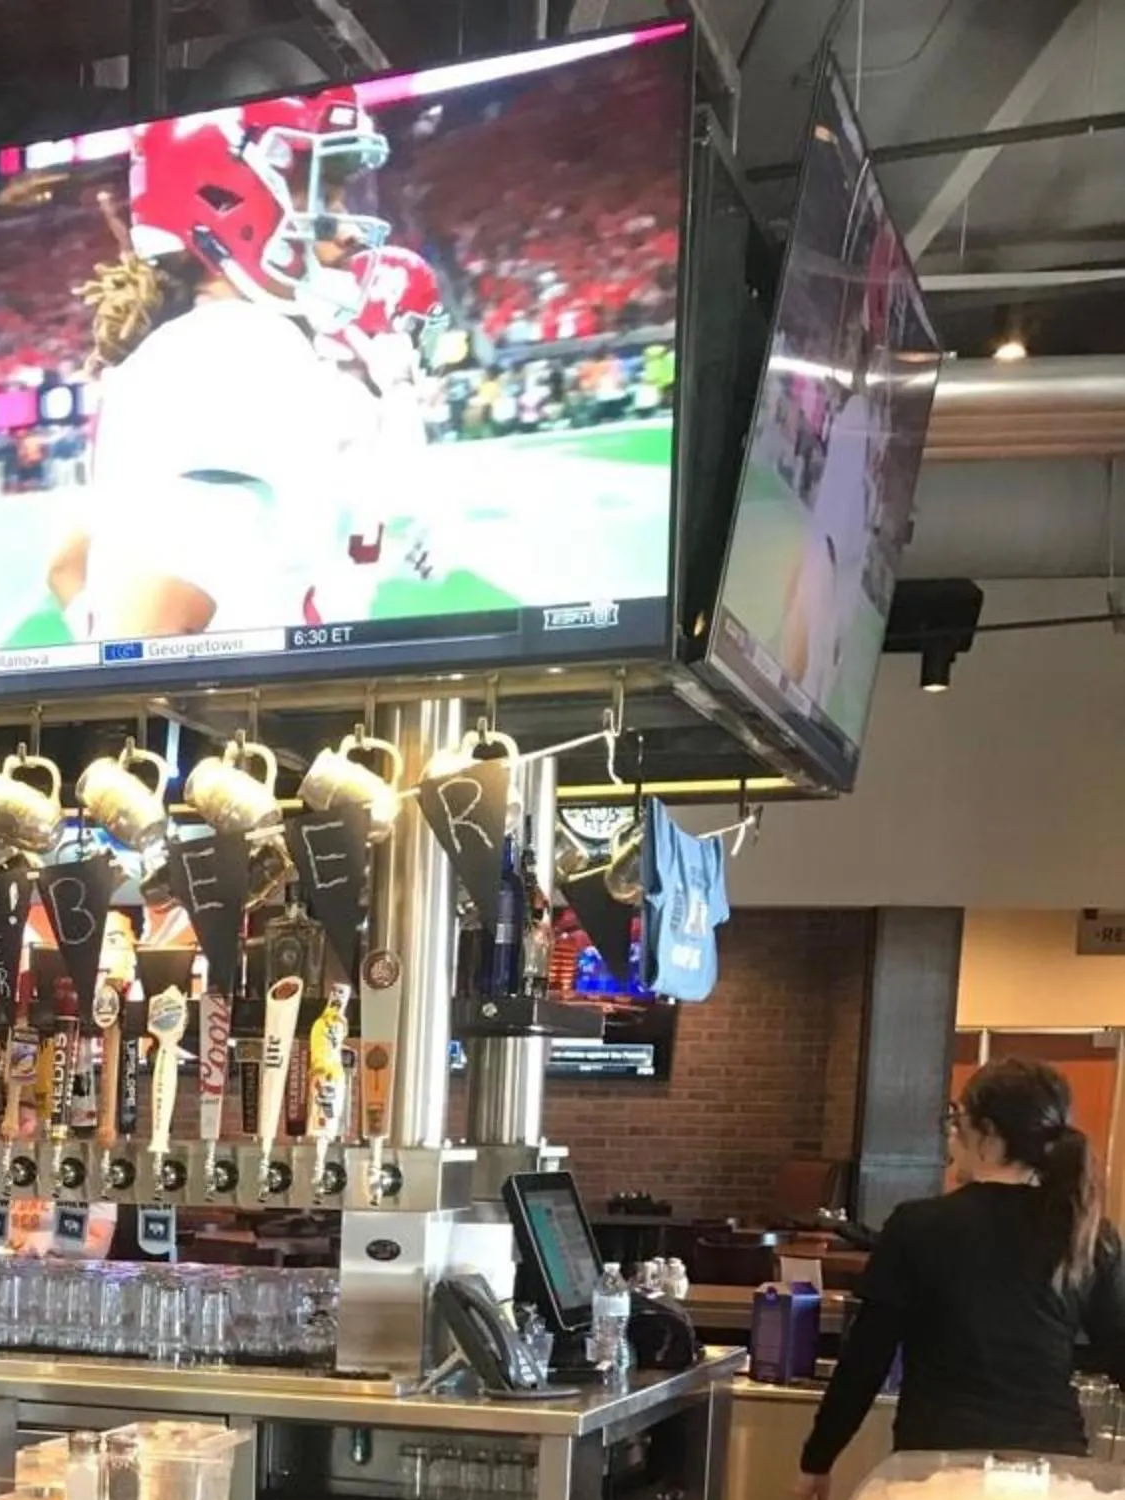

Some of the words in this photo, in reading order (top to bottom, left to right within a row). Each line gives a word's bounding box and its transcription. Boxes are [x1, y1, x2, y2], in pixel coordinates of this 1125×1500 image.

[148, 638, 244, 658] Georgetown
[293, 629, 328, 647] 6:30
[331, 627, 353, 644] ET
[198, 993, 230, 1096] Coors
[125, 1039, 137, 1106] UPSLOPE
